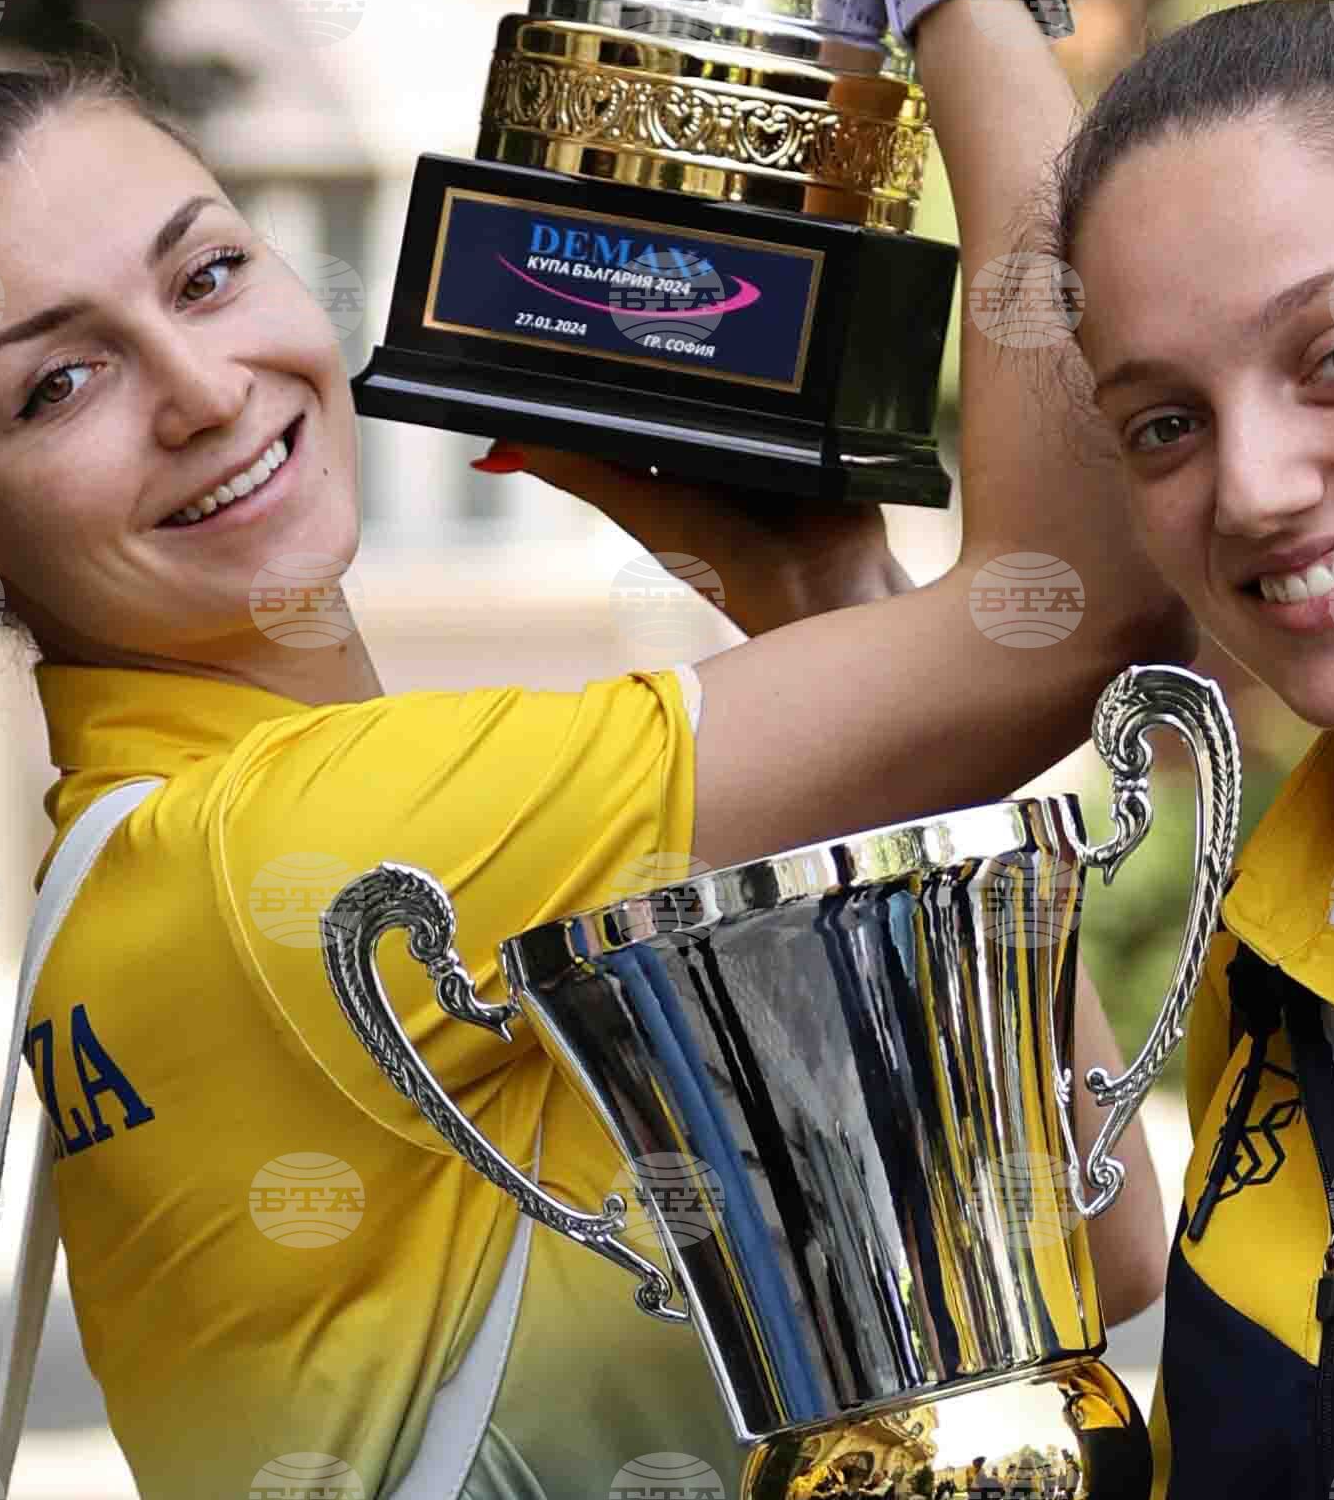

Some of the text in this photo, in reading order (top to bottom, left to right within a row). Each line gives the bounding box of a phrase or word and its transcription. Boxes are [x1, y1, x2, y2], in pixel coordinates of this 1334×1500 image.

[527, 255, 692, 296] КУПА БЪЛГАРИЯ 2024
[515, 312, 588, 336] 27.01.2024
[666, 336, 716, 358] СОФИЯ
